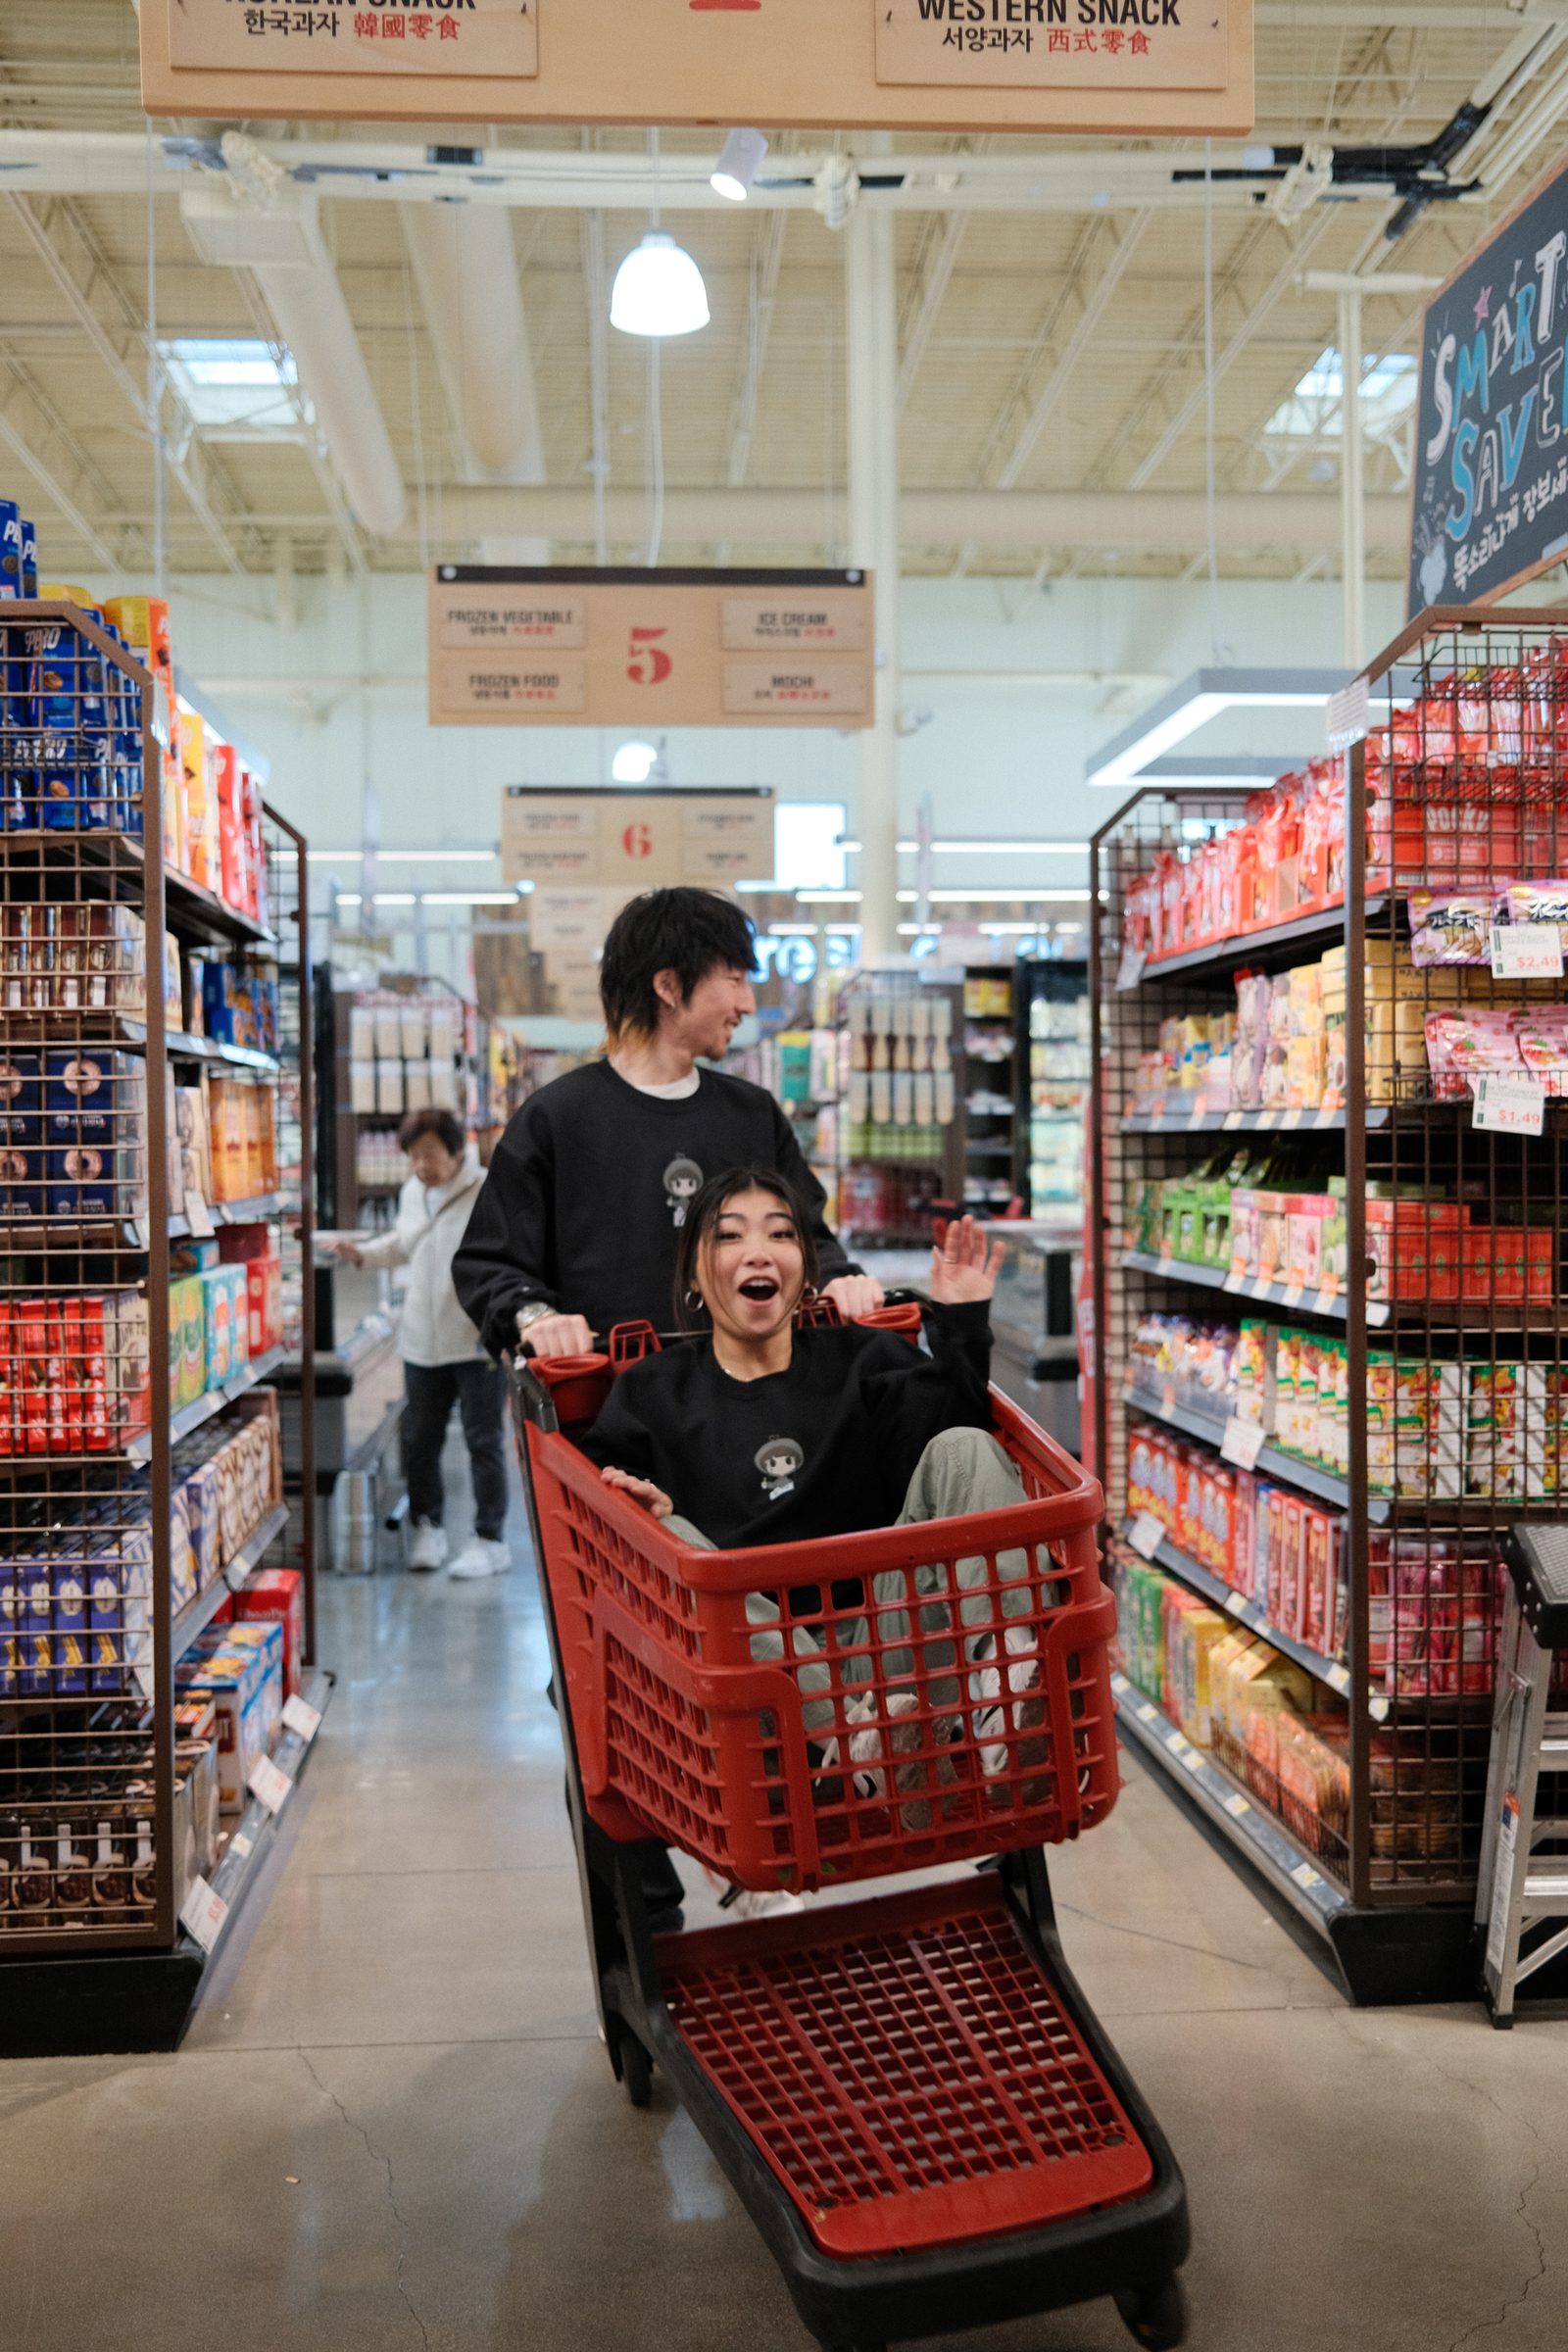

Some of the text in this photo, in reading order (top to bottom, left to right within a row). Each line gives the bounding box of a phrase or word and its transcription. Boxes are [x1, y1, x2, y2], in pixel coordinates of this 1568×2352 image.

[244, 9, 340, 37] 한국과자
[353, 12, 462, 41] 韓國零食
[919, 0, 1181, 26] WESTERN SNACK
[942, 26, 1034, 53] 서양과자
[1047, 27, 1152, 56] 西式零食
[1426, 230, 1566, 466] SMART
[1445, 329, 1568, 542] SAVE
[448, 611, 573, 625] FROZEN VEGETABLE
[759, 612, 827, 626] ICE CREAM
[627, 626, 672, 685] 5
[469, 674, 560, 688] FROZEN FOOD
[622, 822, 654, 859] 6
[1516, 956, 1559, 970] $2.49
